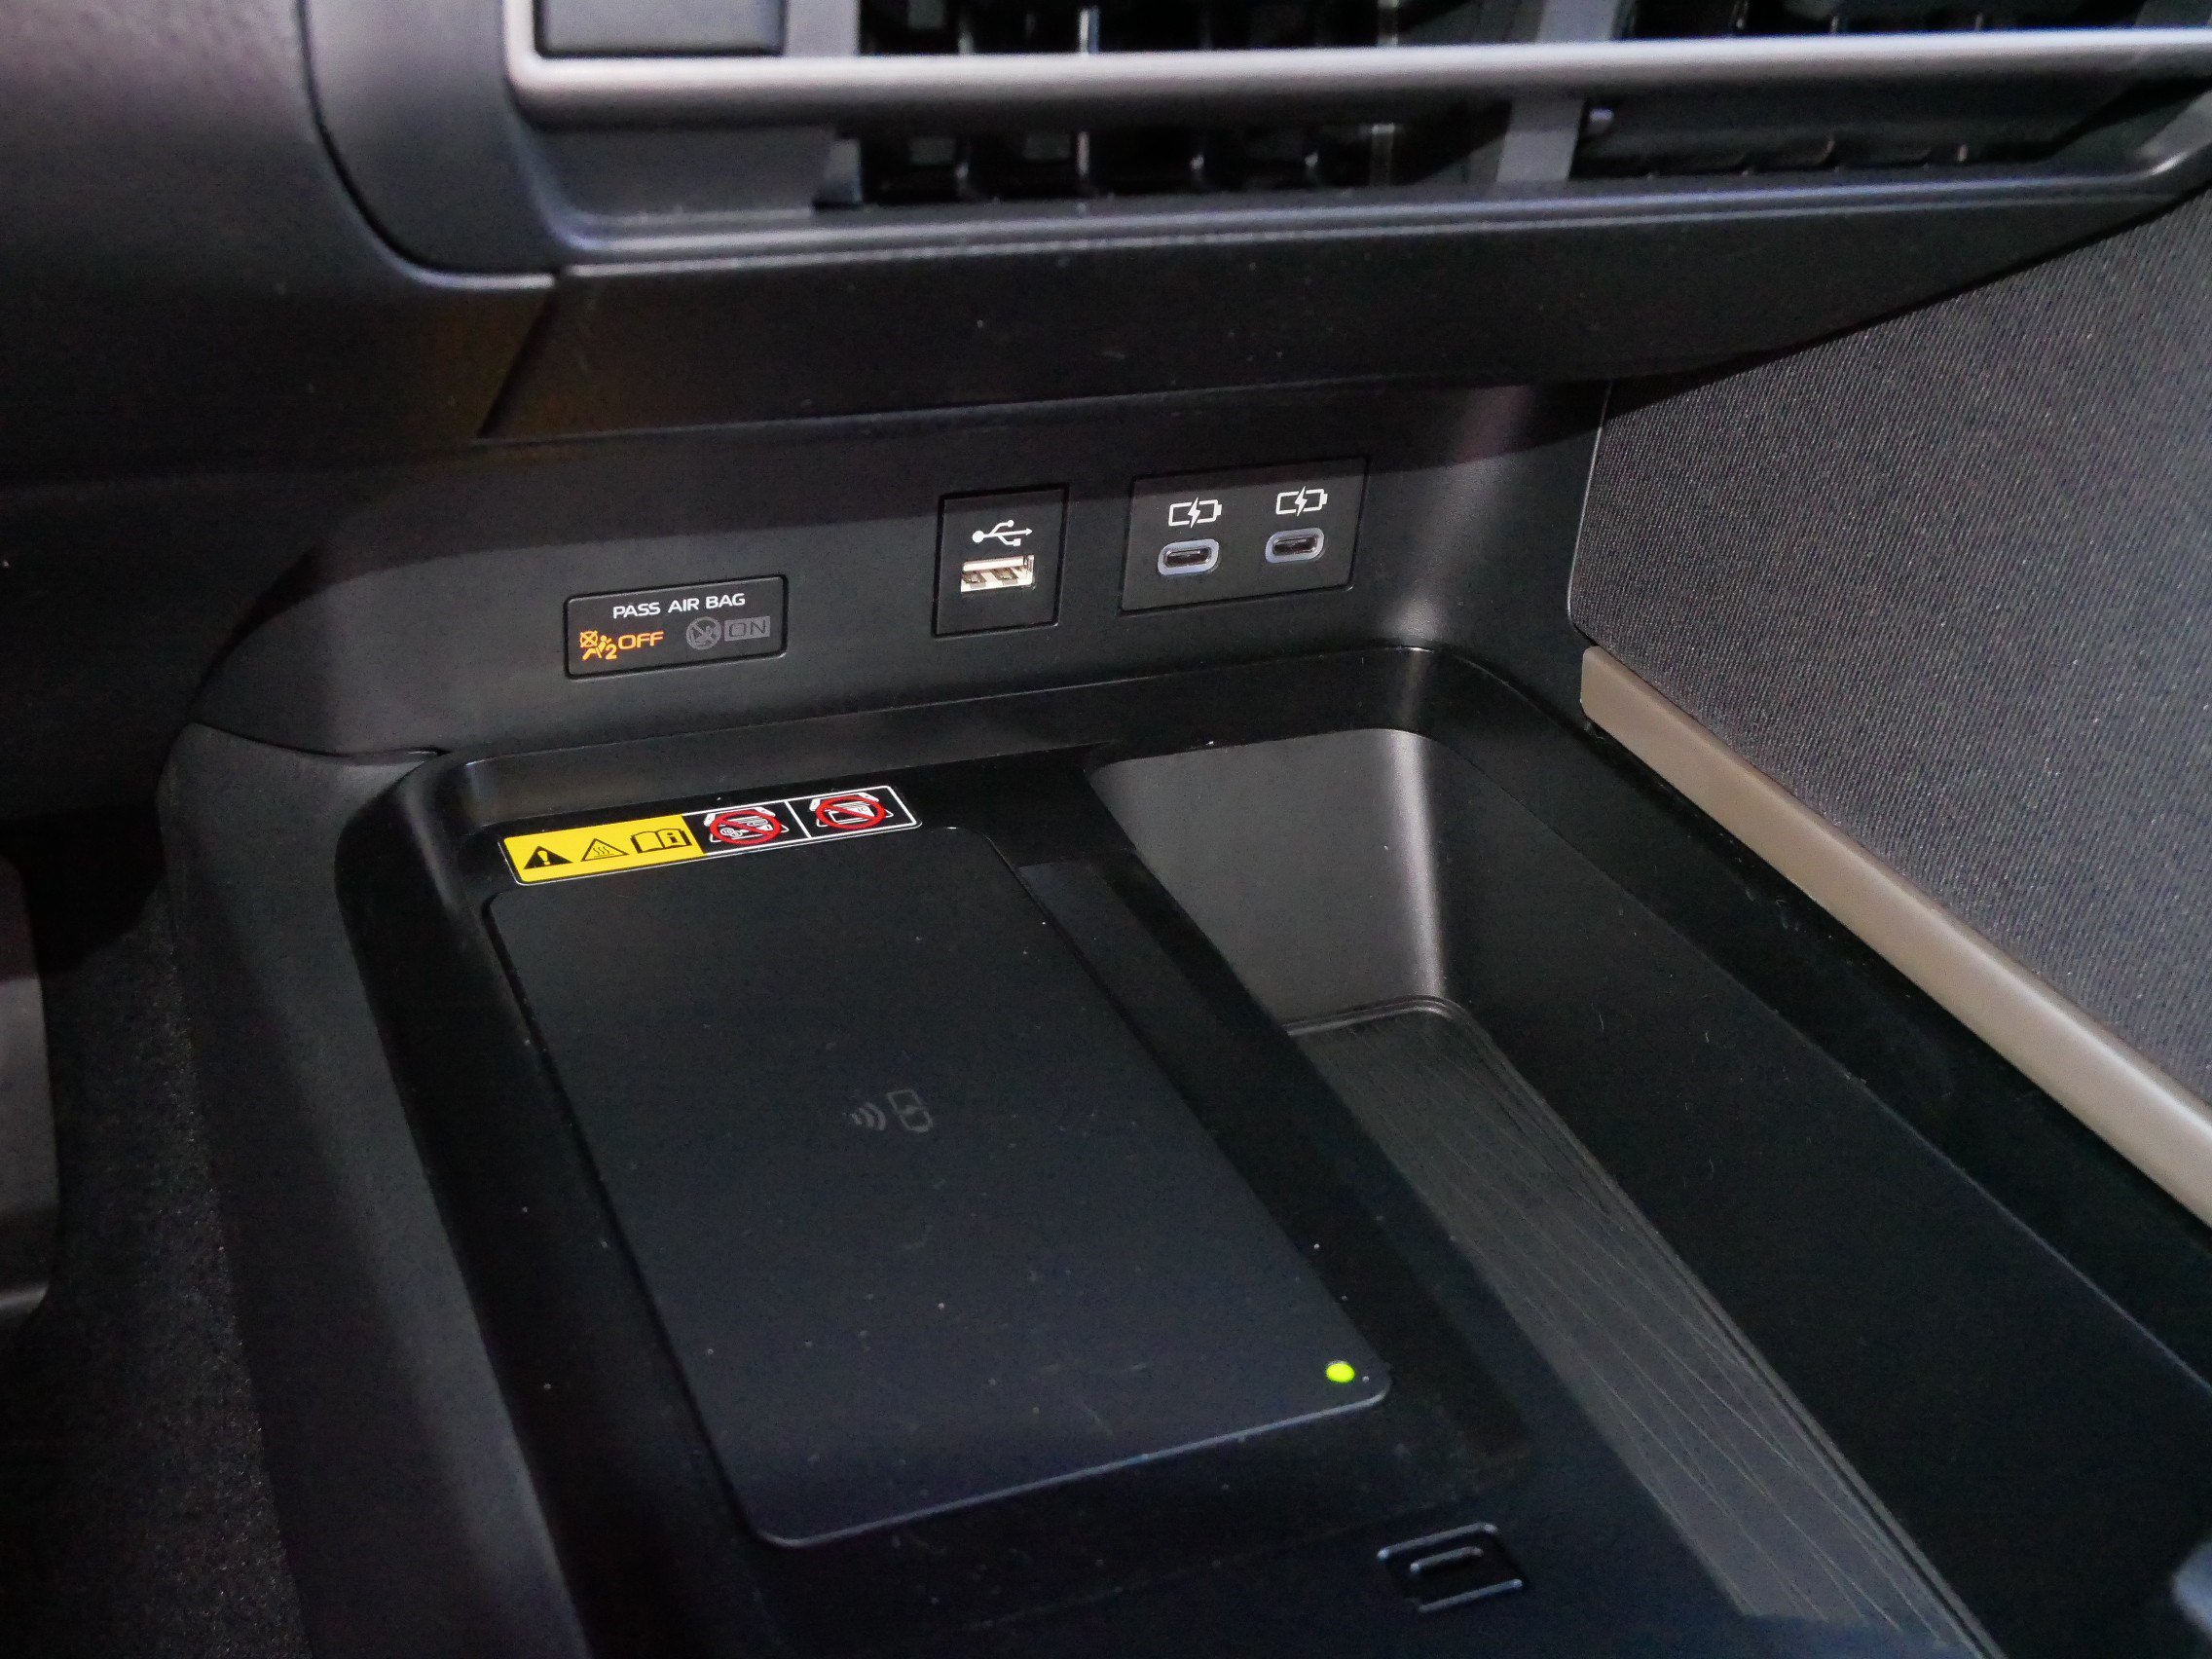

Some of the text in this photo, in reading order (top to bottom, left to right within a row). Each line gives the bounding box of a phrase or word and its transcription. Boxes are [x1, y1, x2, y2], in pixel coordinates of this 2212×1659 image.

[612, 593, 746, 619] PASS AIR BAG
[728, 619, 766, 638] ON
[617, 631, 664, 650] OFF
